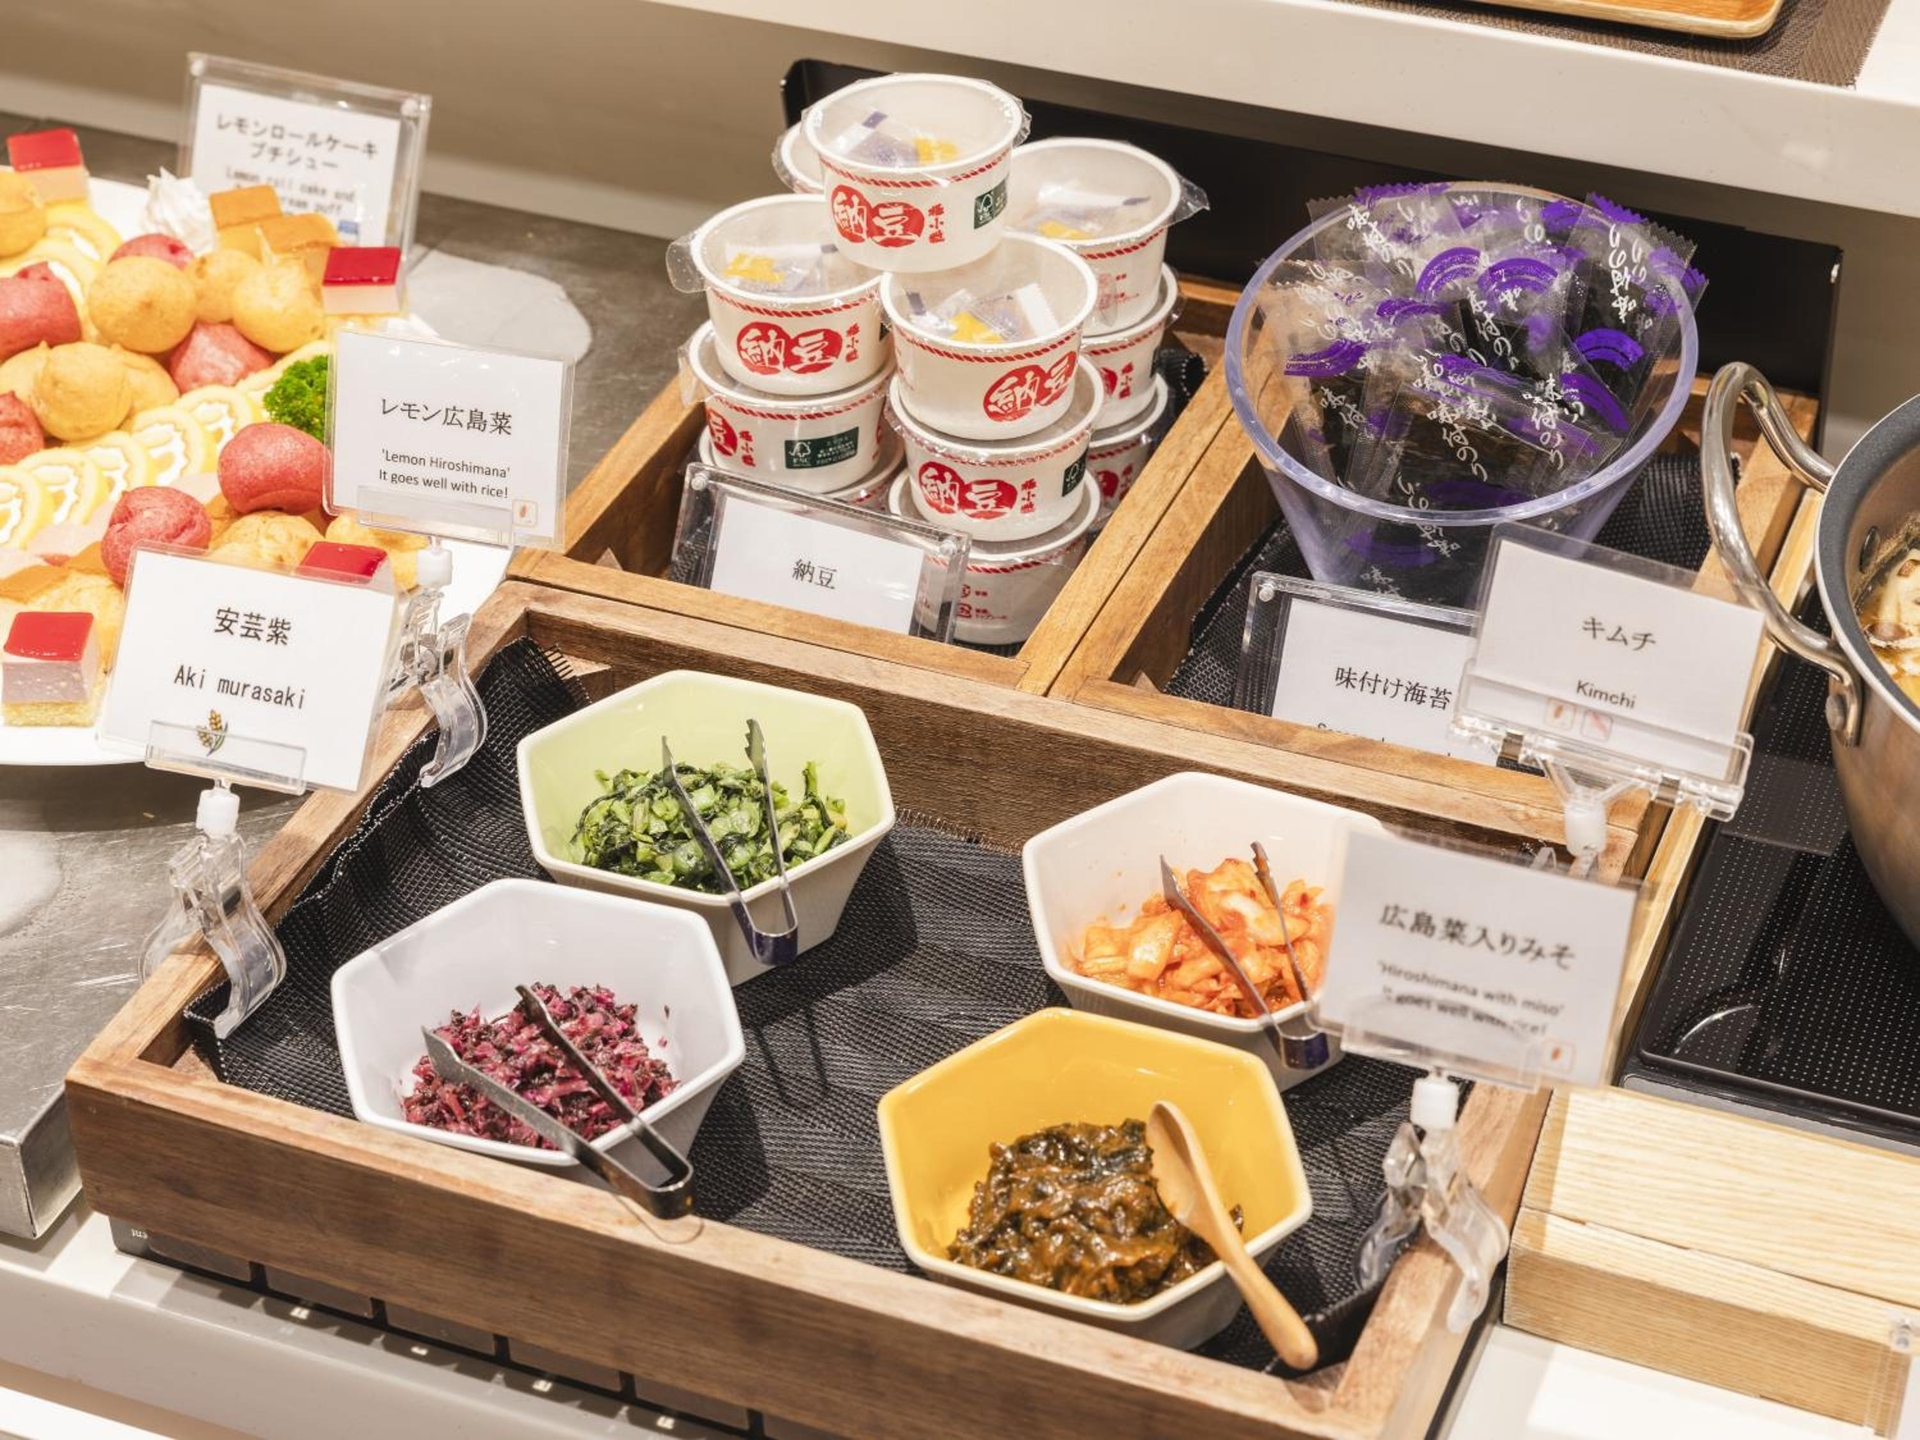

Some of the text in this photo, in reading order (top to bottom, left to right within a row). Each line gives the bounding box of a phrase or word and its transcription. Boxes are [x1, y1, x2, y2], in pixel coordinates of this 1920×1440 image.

[216, 113, 377, 159] レモンロールケーキ
[251, 141, 339, 169] プチシュー
[738, 325, 841, 373] 納豆
[984, 352, 1077, 421] 納豆
[380, 398, 513, 436] レモン広島菜
[382, 448, 511, 479] 'Lemon Hiroshimana'
[379, 469, 509, 499] It goes well with rice!
[919, 462, 1018, 520] 納豆
[791, 558, 838, 591] 納豆
[214, 607, 292, 646] 安芸紫
[1581, 615, 1657, 652] キムチ
[174, 664, 306, 709] Aki murasaki
[1334, 666, 1453, 710] 味付け海苔
[1576, 679, 1637, 710] Kimchi
[1378, 904, 1577, 971] 広島菜入りみそ
[1483, 987, 1518, 1006] with
